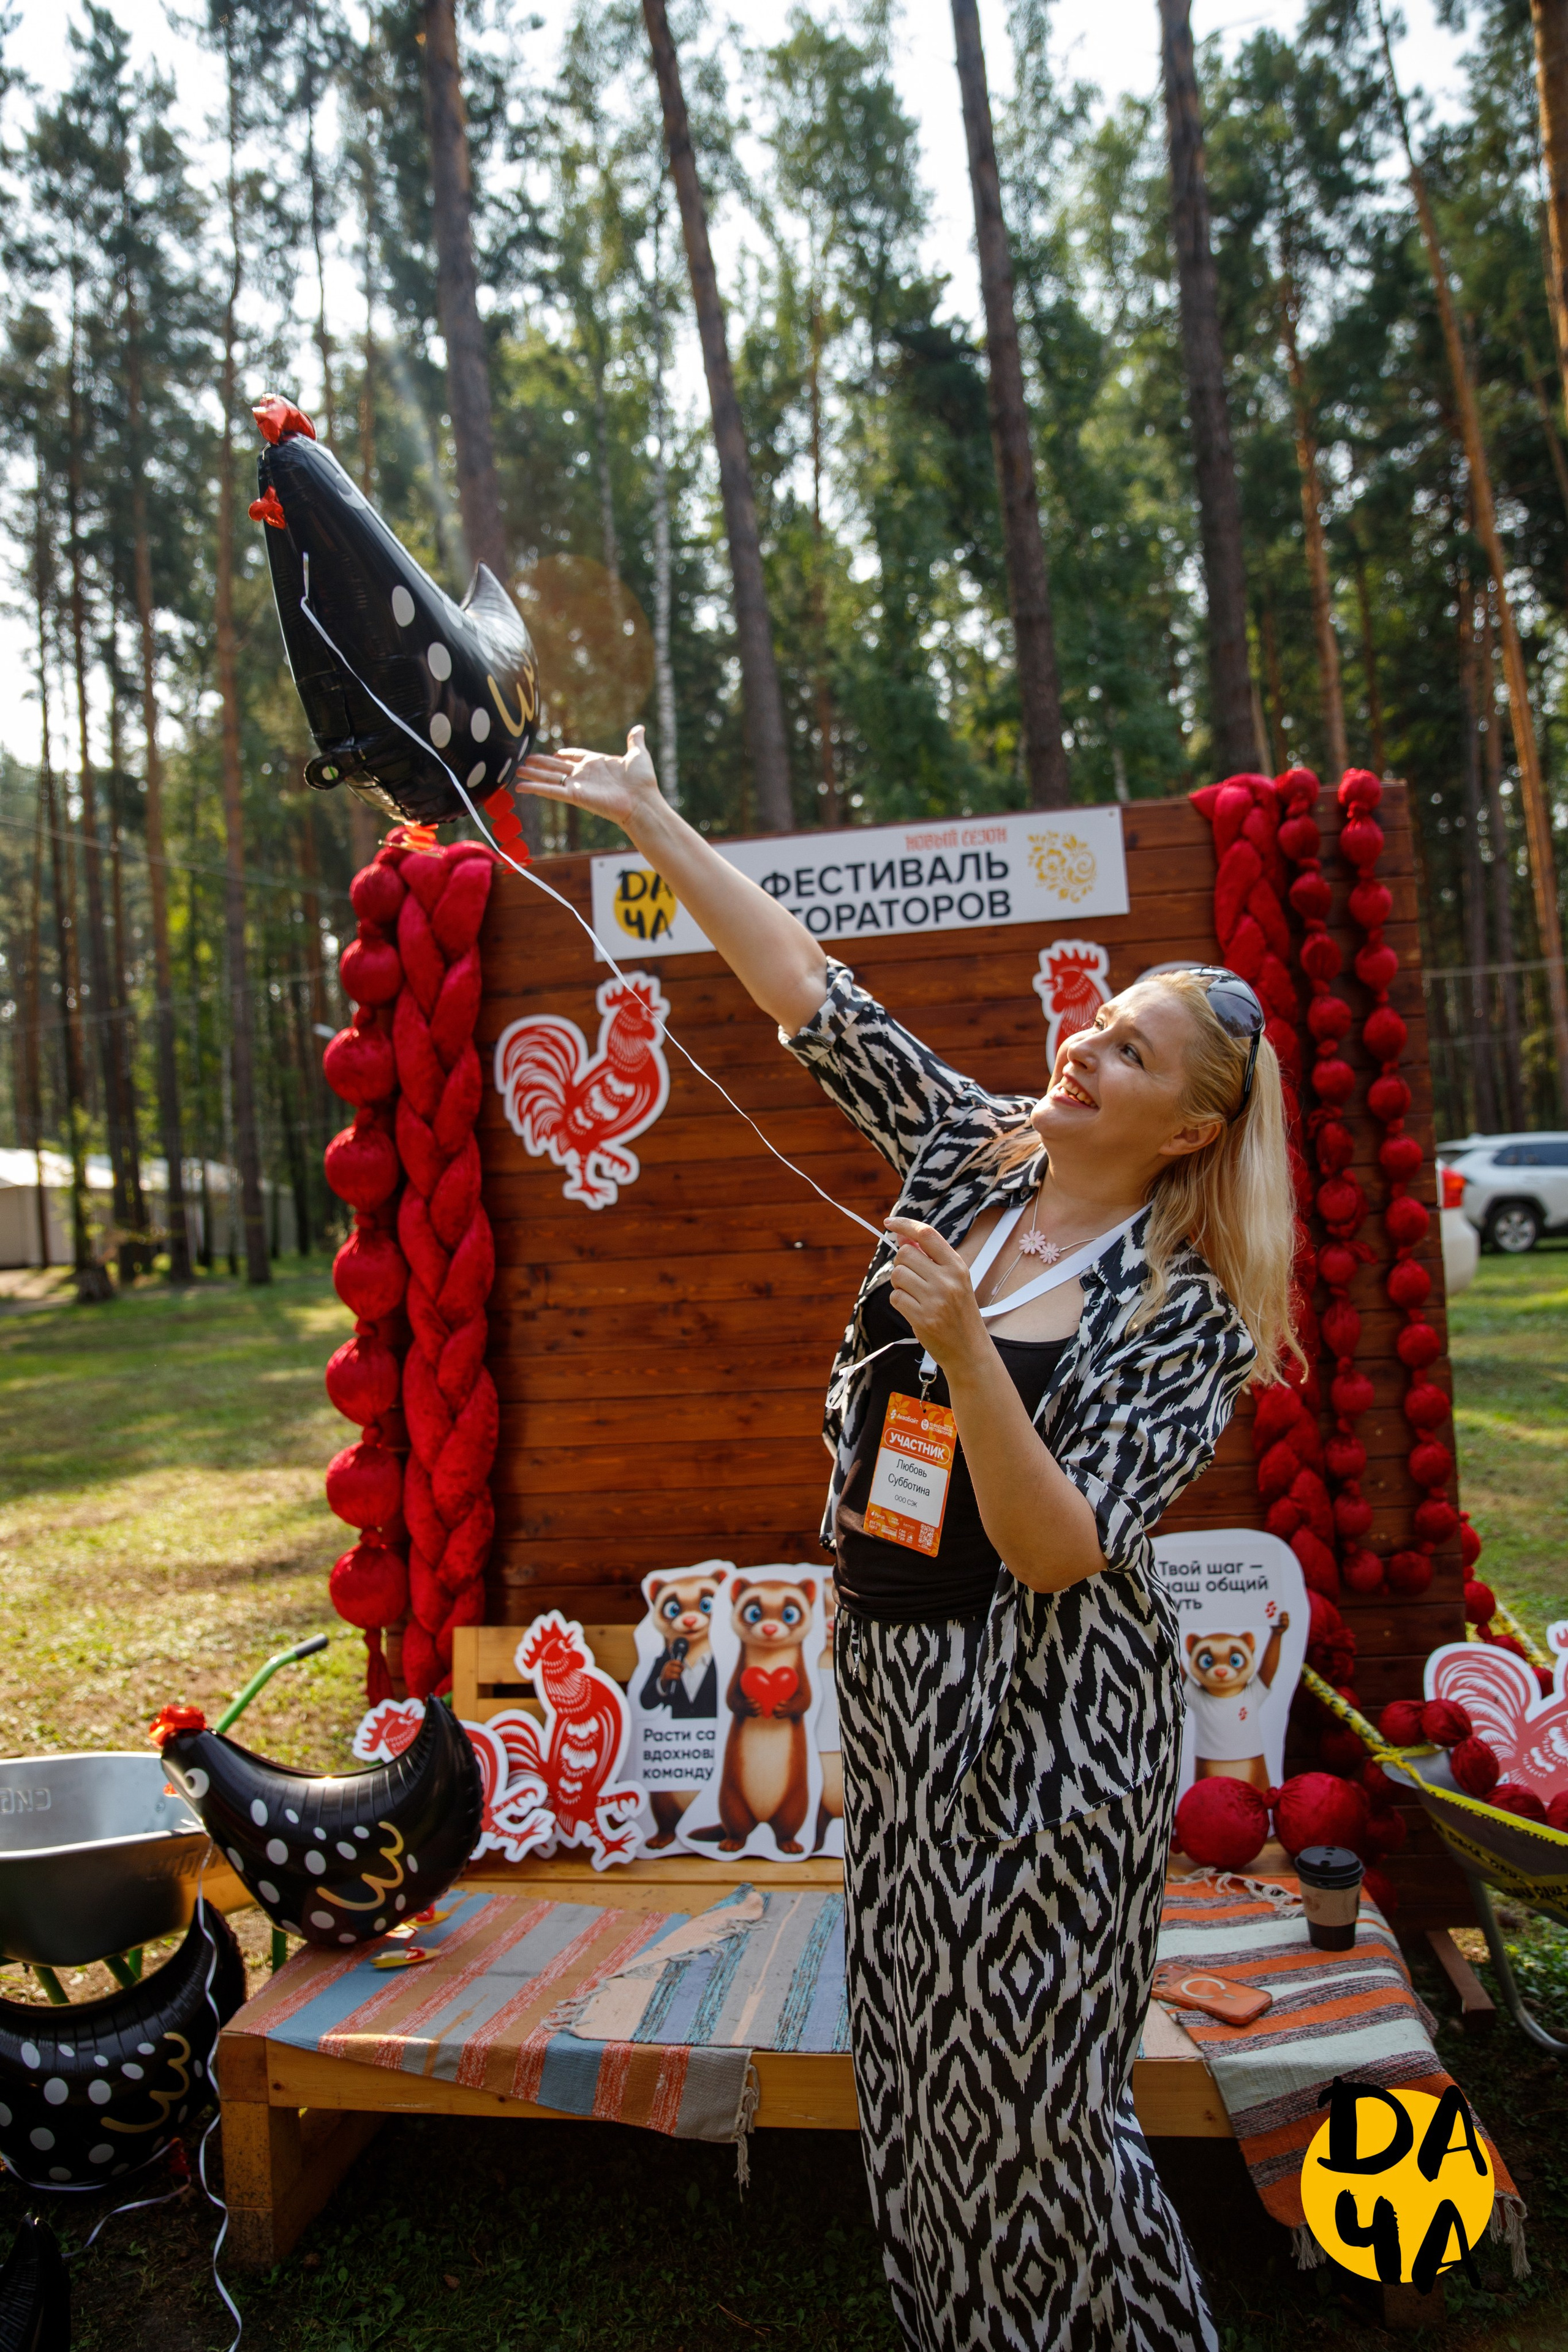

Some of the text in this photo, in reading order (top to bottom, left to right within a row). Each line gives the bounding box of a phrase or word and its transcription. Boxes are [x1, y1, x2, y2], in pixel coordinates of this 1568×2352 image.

[906, 826, 1008, 851] НОВЫЙ СЕЗОН
[761, 851, 1009, 899] ФЕСТИВАЛЬ
[889, 1432, 945, 1460] УЧАСТНИК
[896, 1458, 927, 1478] Любовь
[888, 1473, 930, 1496] Субботина
[894, 1494, 918, 1507] ООО СЭК
[1158, 1561, 1201, 1575] Твой
[1207, 1562, 1243, 1575] шаг
[1205, 1575, 1268, 1593] общий
[1172, 1597, 1203, 1613] уть
[644, 1728, 692, 1741] Расти
[643, 1766, 714, 1781] команду
